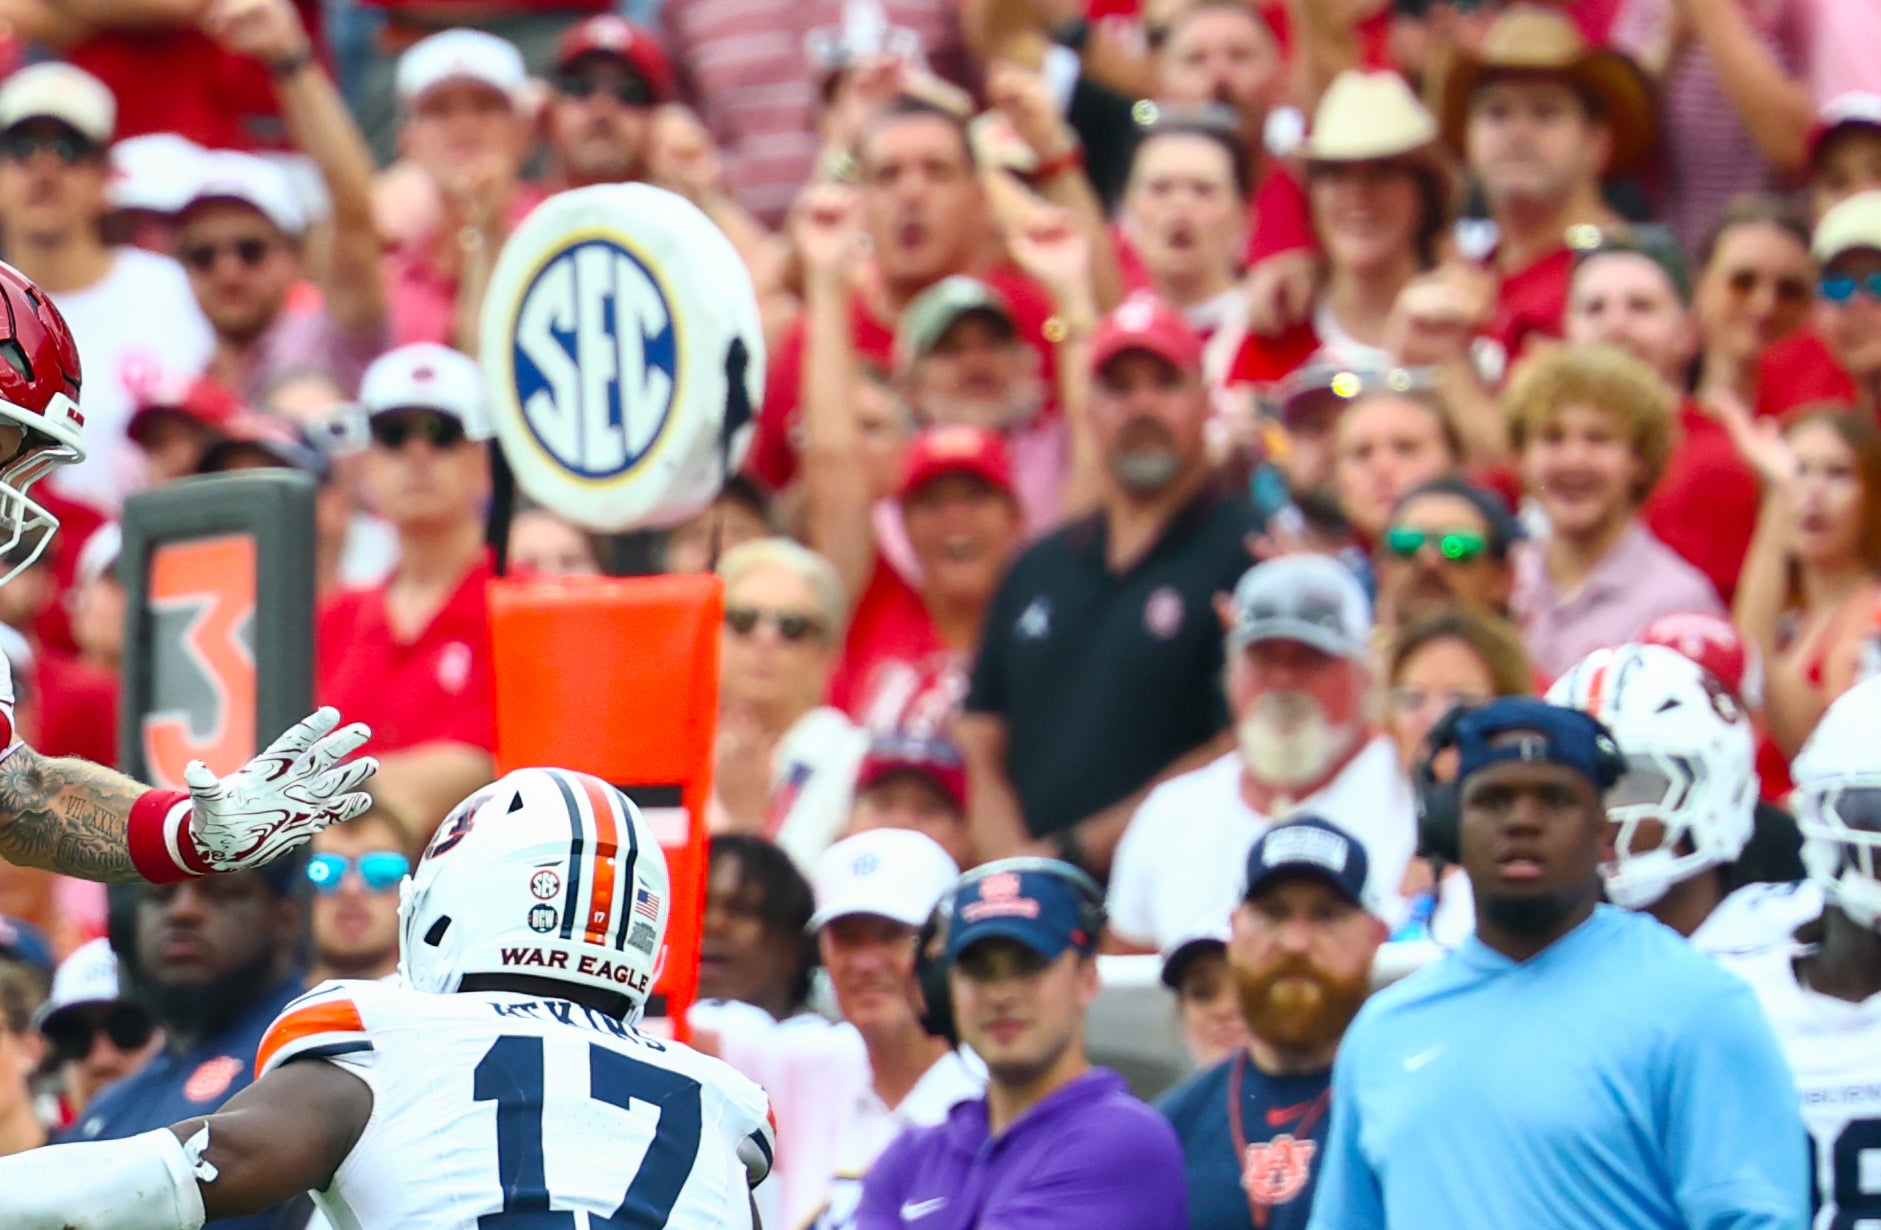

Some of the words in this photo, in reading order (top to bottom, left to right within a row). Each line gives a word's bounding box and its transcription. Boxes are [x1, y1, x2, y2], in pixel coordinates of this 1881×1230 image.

[517, 247, 674, 470] SEC
[142, 532, 258, 793] 3
[531, 871, 559, 899] SEC
[593, 911, 606, 924] 17
[500, 948, 569, 969] WAR
[577, 955, 650, 995] EAGLE
